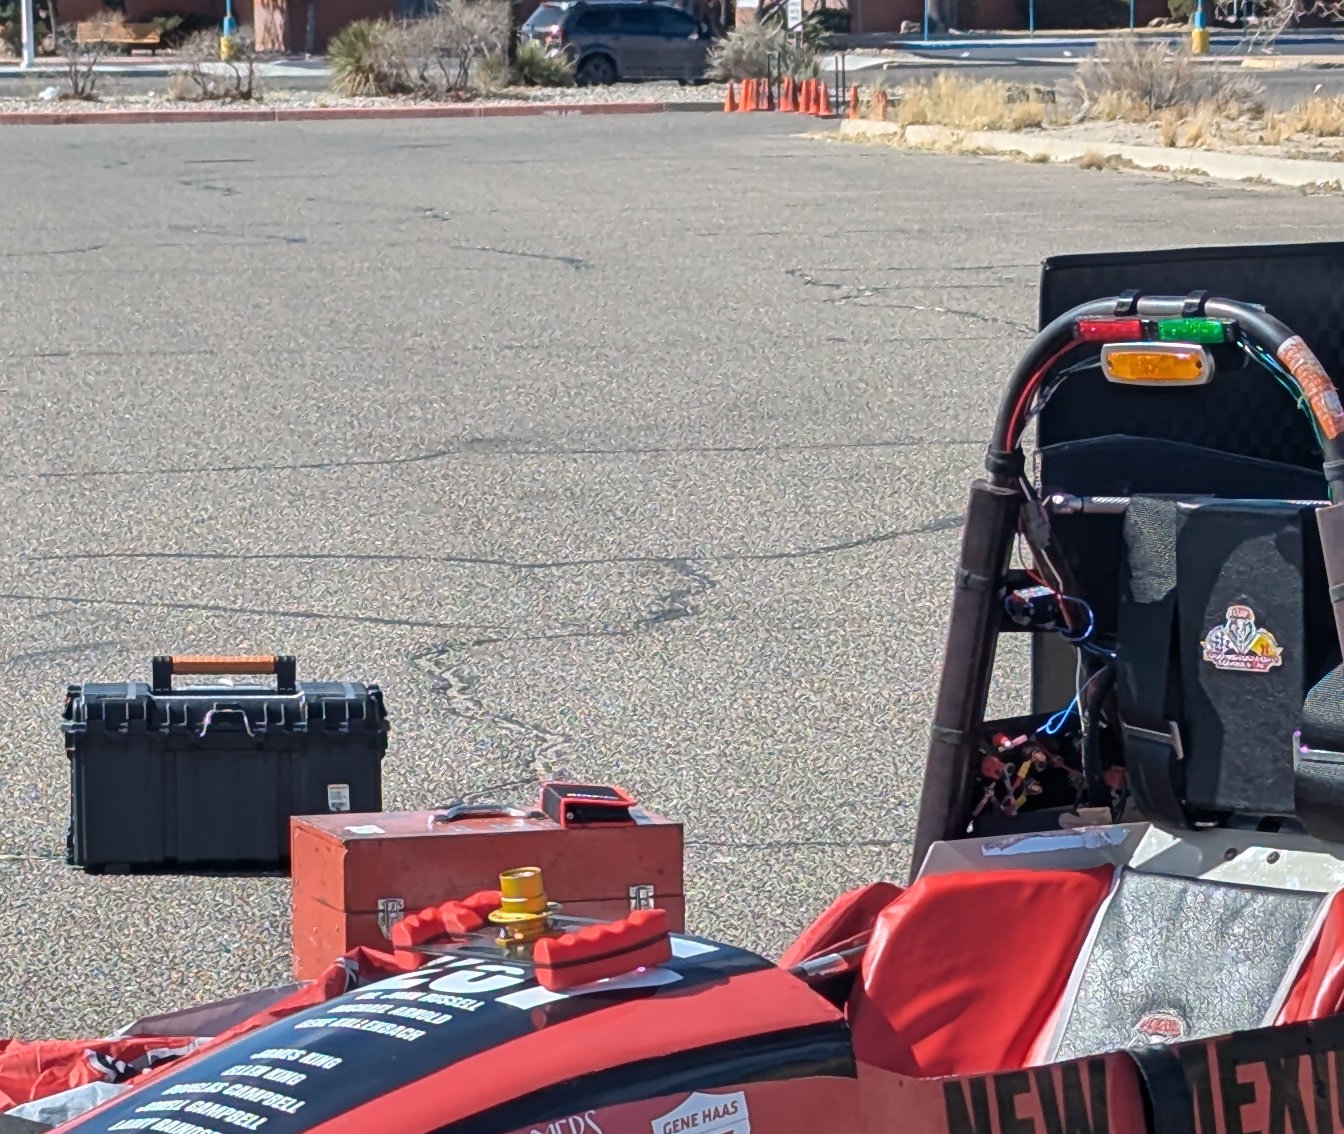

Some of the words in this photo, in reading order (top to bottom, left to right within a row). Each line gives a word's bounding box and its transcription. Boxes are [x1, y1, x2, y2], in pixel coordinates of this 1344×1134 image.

[298, 1050, 343, 1070] KING
[262, 1066, 307, 1086] KING
[222, 1083, 306, 1114] CAMPBELL
[184, 1100, 268, 1131] CAMPBELL
[701, 1100, 739, 1124] HAAS
